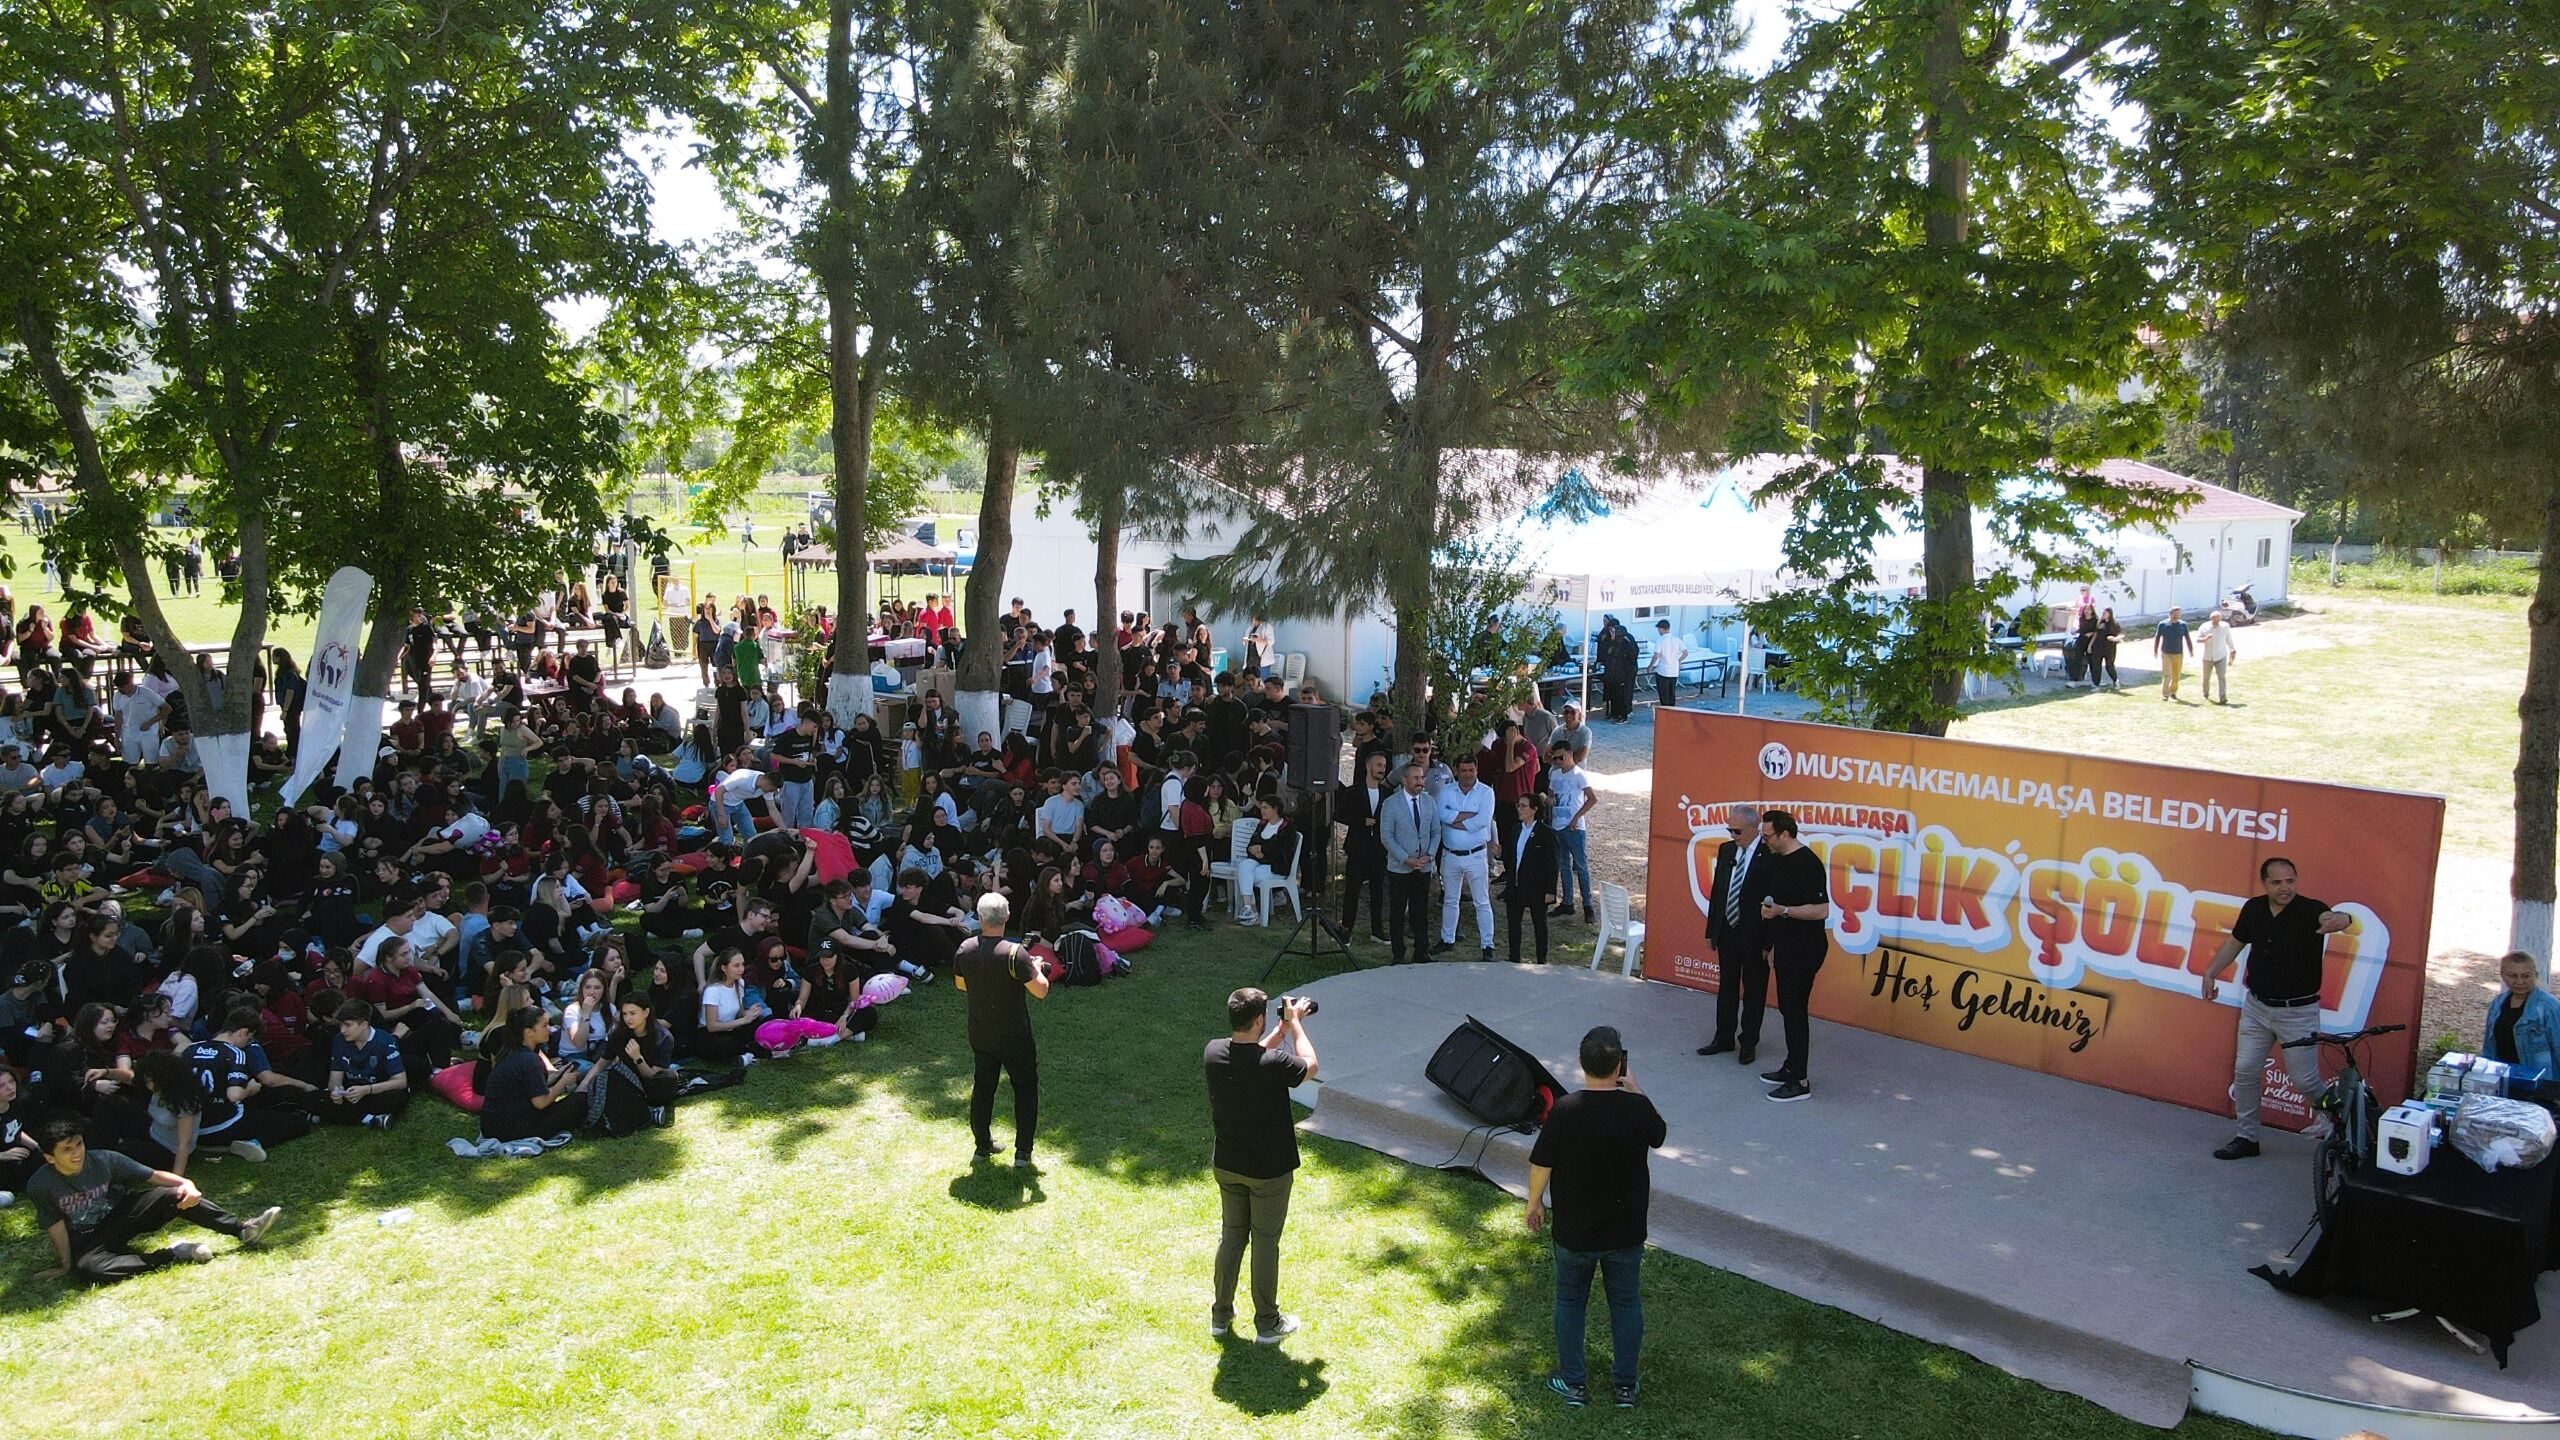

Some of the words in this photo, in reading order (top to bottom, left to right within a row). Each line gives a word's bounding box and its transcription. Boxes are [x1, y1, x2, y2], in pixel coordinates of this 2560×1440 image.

[1795, 752, 2096, 819] MUSTAFAKEMALPAŞA
[2102, 791, 2289, 842] BELEDİYESİ
[1694, 833, 2000, 933] ÇLİK
[2027, 856, 2363, 1011] ŞÖLEİ
[1870, 950, 1940, 1012] Hoş
[1951, 970, 2100, 1053] Geldiniz
[2266, 1069, 2294, 1086] ŞÜK
